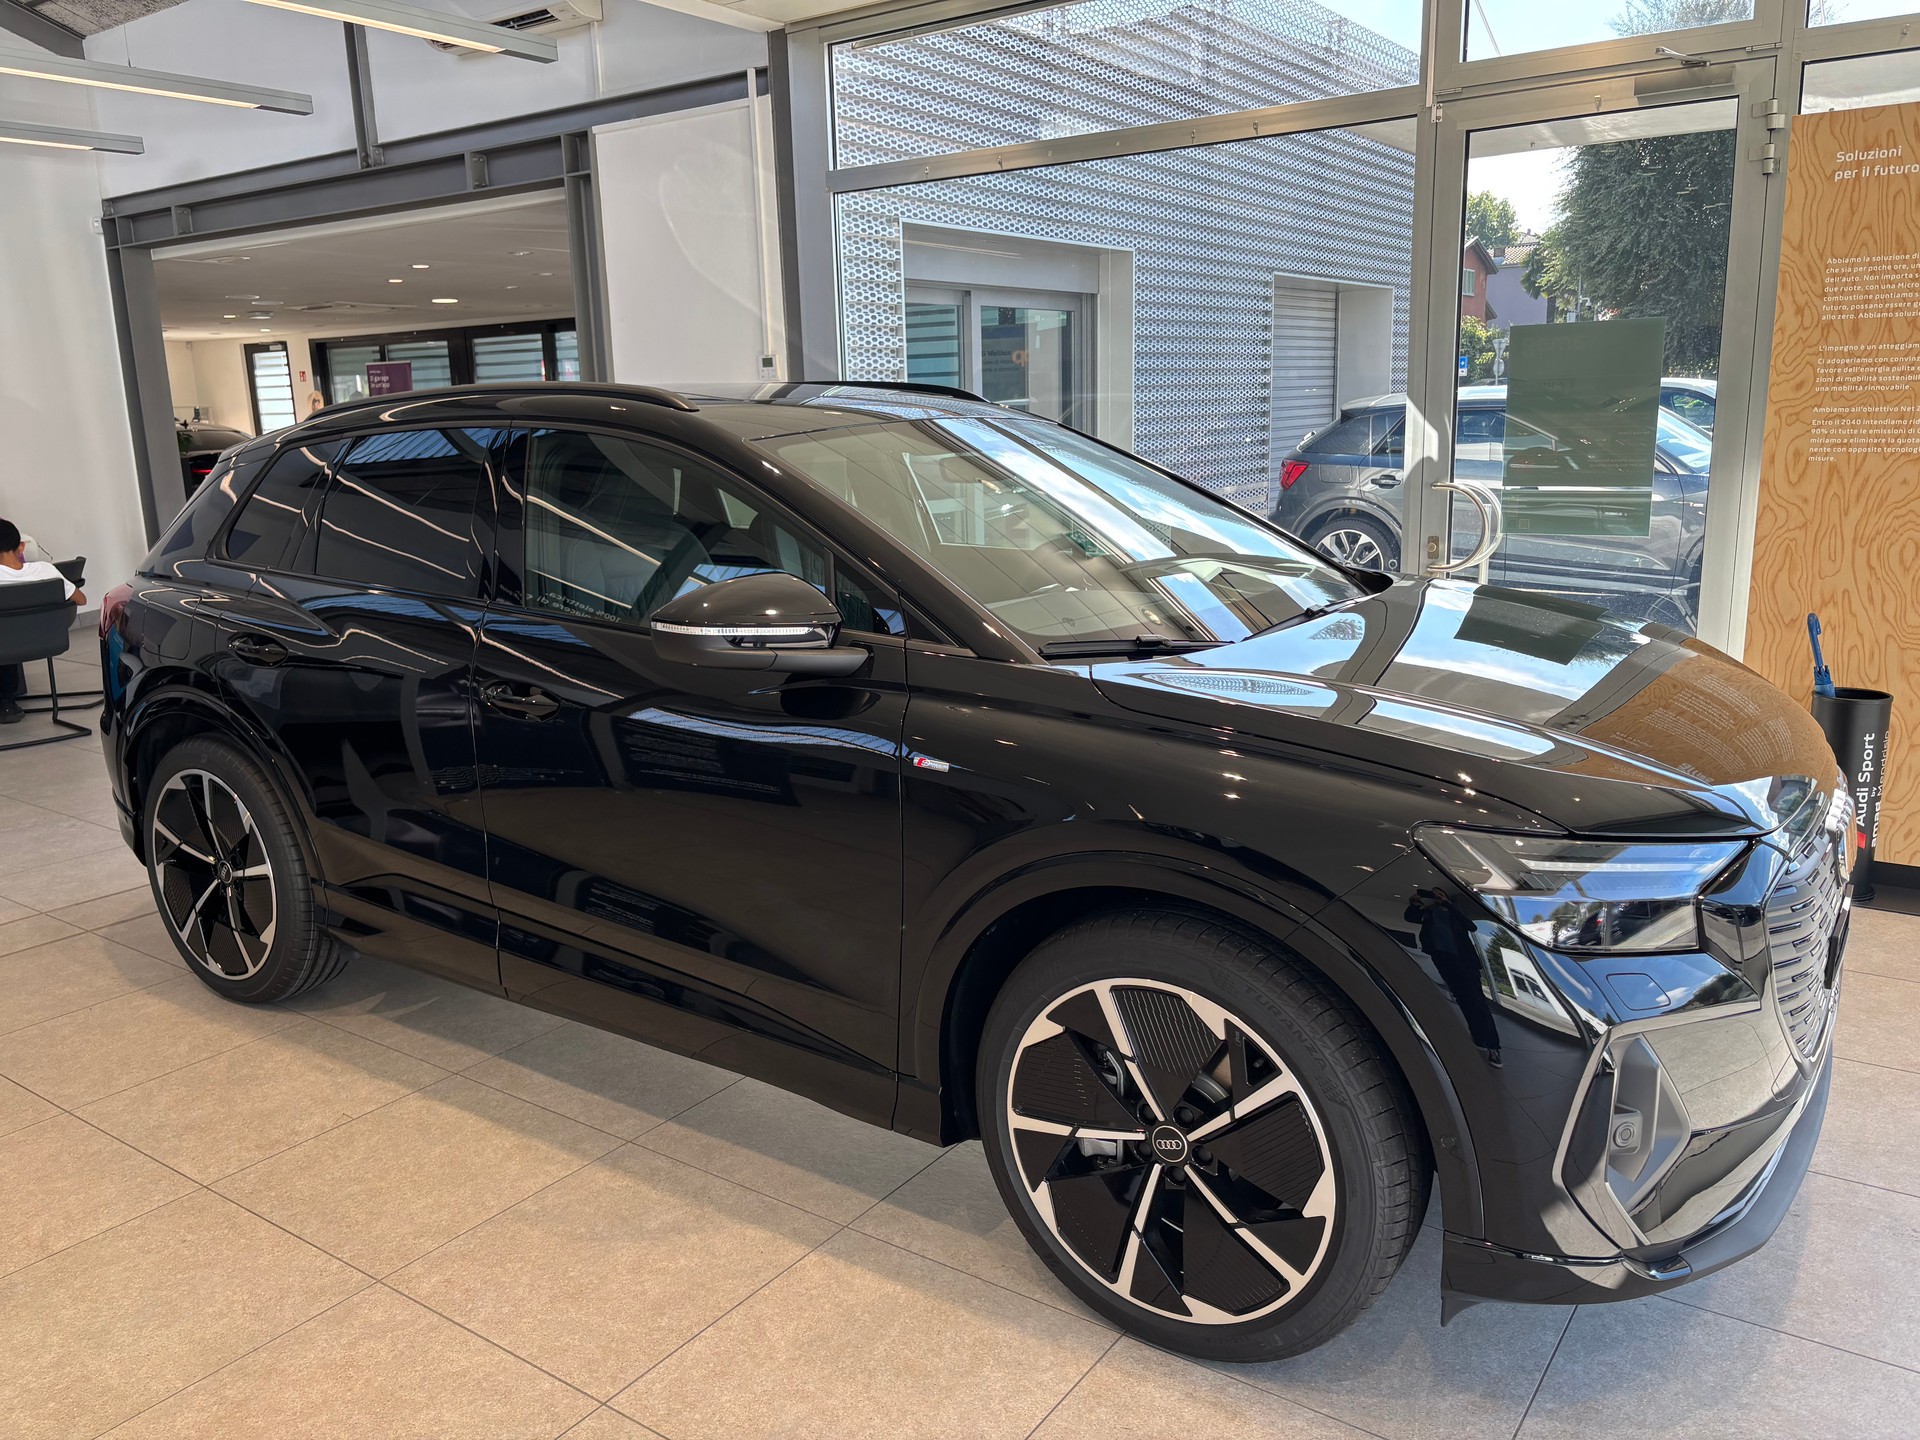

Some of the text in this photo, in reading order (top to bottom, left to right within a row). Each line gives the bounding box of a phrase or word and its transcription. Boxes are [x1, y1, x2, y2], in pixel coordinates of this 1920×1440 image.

[1836, 146, 1902, 162] Soluzioni
[1835, 164, 1920, 182] per il futuro
[1872, 254, 1910, 262] soluzione
[1823, 293, 1873, 302] combustione
[1875, 292, 1913, 300] puntiamo
[1856, 733, 1875, 827] Audi Sport
[1871, 786, 1877, 797] by
